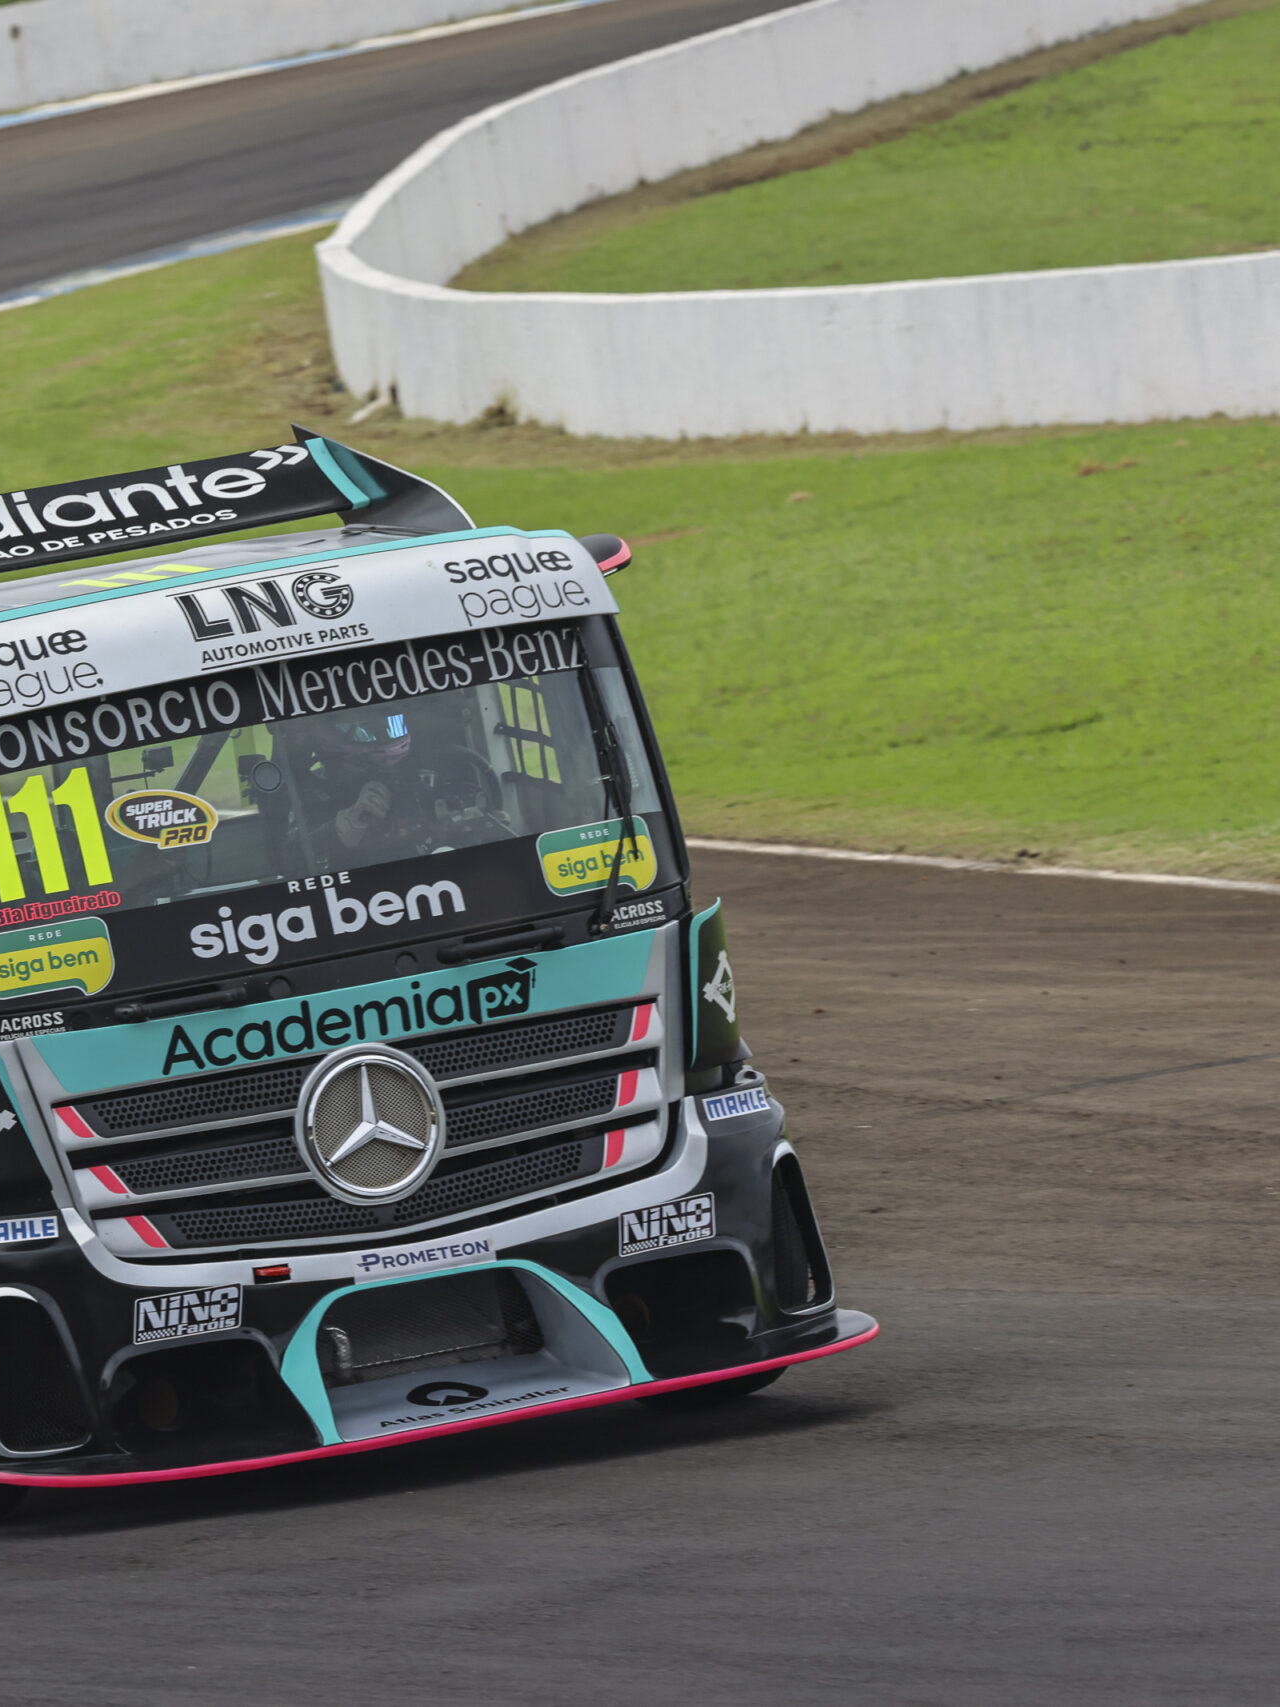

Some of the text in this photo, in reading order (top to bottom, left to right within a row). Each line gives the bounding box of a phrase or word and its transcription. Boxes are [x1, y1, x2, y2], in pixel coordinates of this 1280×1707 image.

[43, 536, 81, 553] DE
[88, 509, 238, 544] PESADOS
[174, 572, 354, 643] LNG
[201, 622, 370, 666] AUTOMOTIVE PARTS
[250, 626, 586, 722] Mercedes-Benz
[126, 799, 173, 817] SUPER
[134, 807, 197, 830] TRUCK
[164, 825, 208, 846] PRO
[580, 828, 610, 840] REDE
[557, 857, 599, 880] siga
[287, 871, 352, 894] REDE
[23, 890, 121, 921] Figueiredo
[610, 900, 664, 922] ACROSS
[189, 878, 466, 965] siga bem
[28, 929, 62, 942] REDE
[48, 949, 99, 970] bem
[0, 1011, 64, 1033] ACROSS
[161, 979, 524, 1076] Academia px
[705, 1090, 767, 1119] MAHLE
[658, 1227, 711, 1247] Faróis
[356, 1240, 490, 1272] PROMETEON
[176, 1317, 236, 1336] Faróis
[380, 1386, 570, 1428] Atlas Schindler
